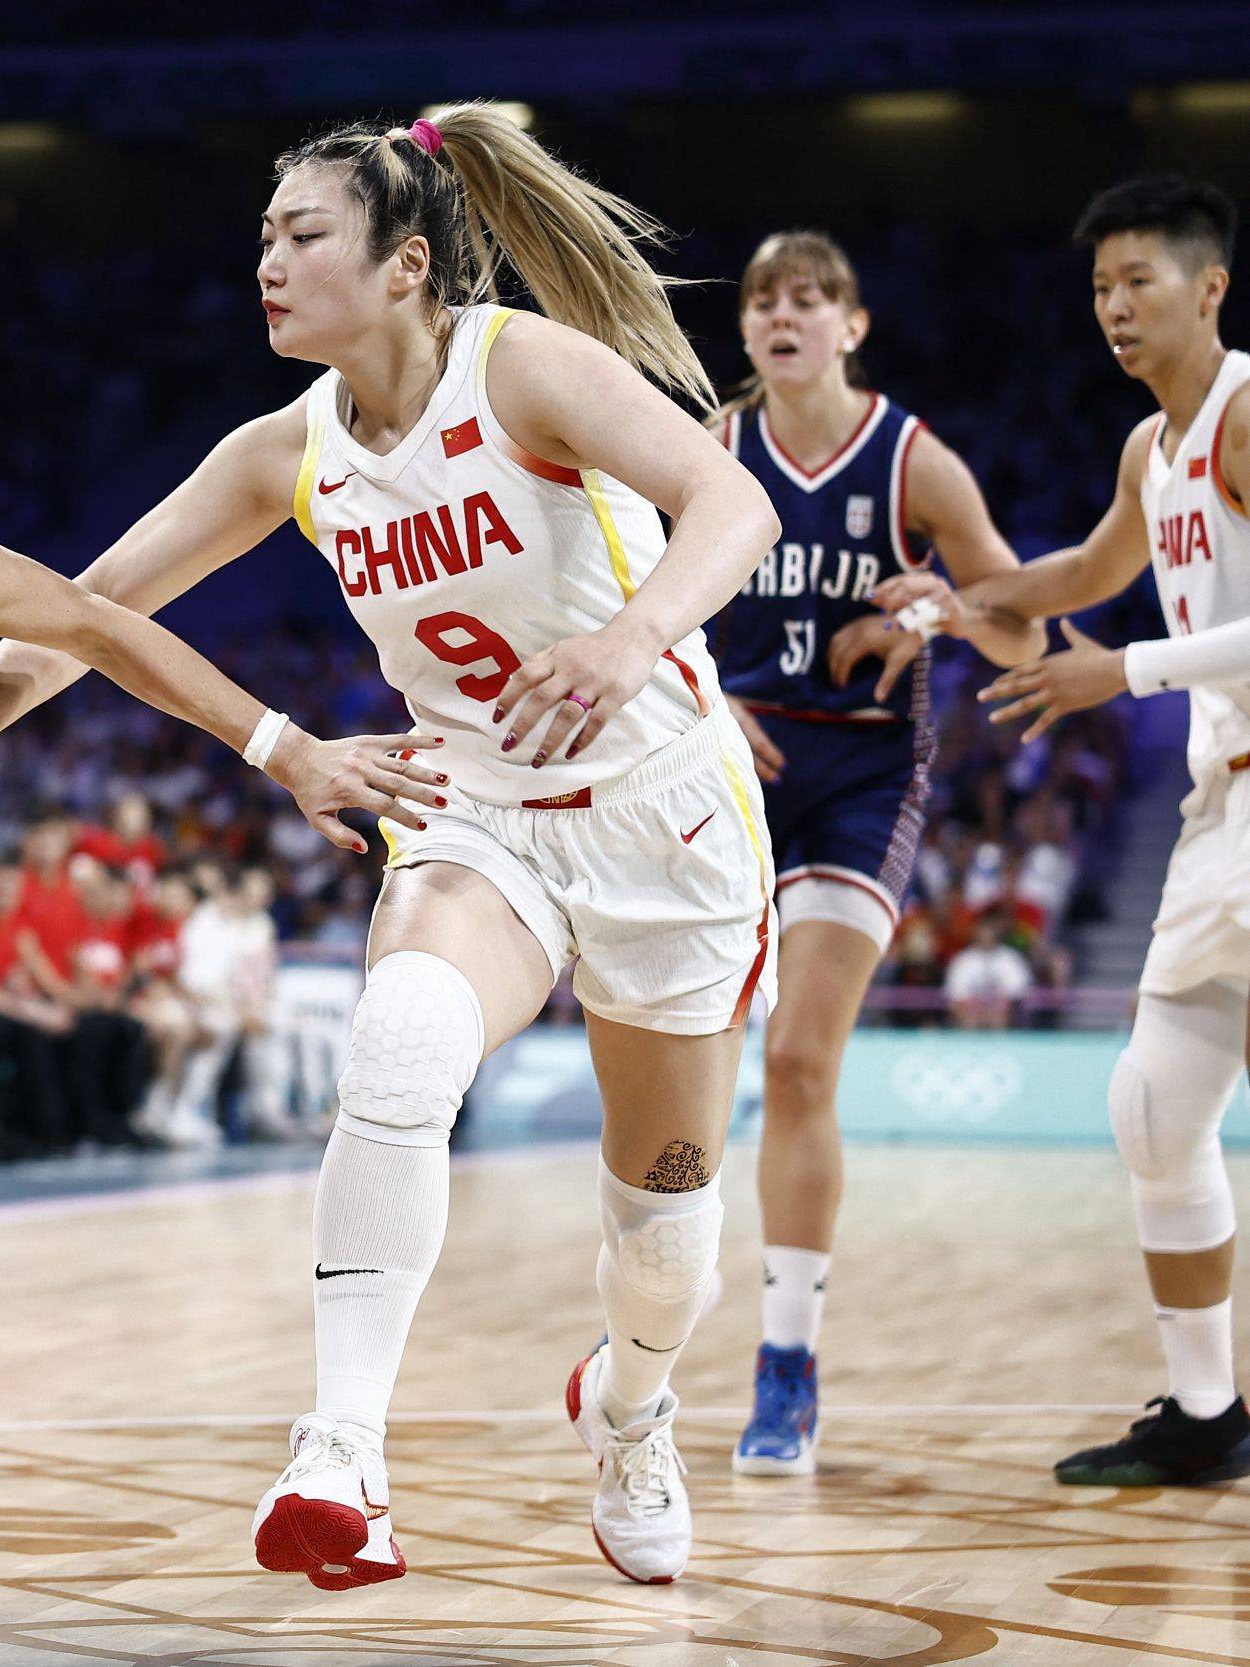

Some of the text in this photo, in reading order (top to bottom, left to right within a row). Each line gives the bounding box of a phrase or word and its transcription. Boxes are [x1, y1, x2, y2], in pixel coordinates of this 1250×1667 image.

[335, 490, 525, 597] CHINA
[739, 542, 881, 601] RBIJA
[414, 610, 522, 703] 9
[779, 618, 816, 676] 51
